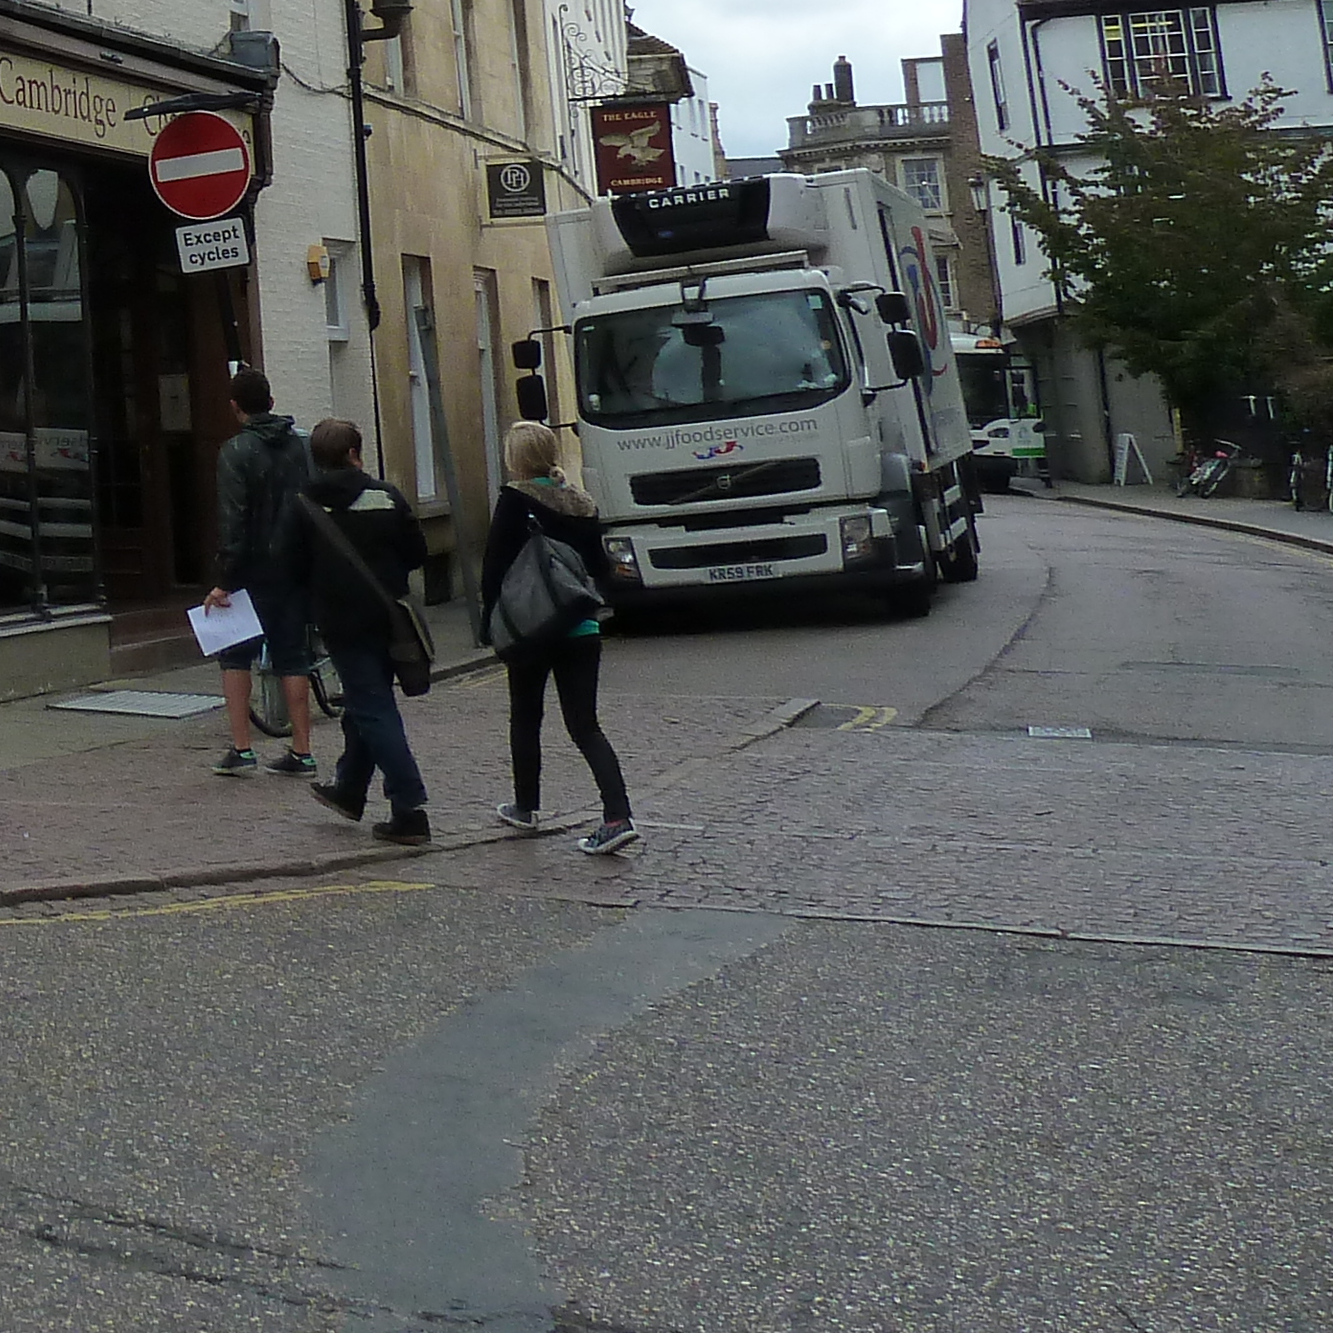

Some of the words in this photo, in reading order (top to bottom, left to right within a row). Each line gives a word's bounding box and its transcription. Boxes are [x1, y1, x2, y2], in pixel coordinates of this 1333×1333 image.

[624, 111, 657, 120] EAGLE
[610, 177, 664, 186] CAMBRIDGE
[648, 188, 730, 209] CARRIER
[183, 226, 240, 247] Except
[189, 246, 239, 266] cycles
[617, 418, 818, 451] www.jjfoodservice.com
